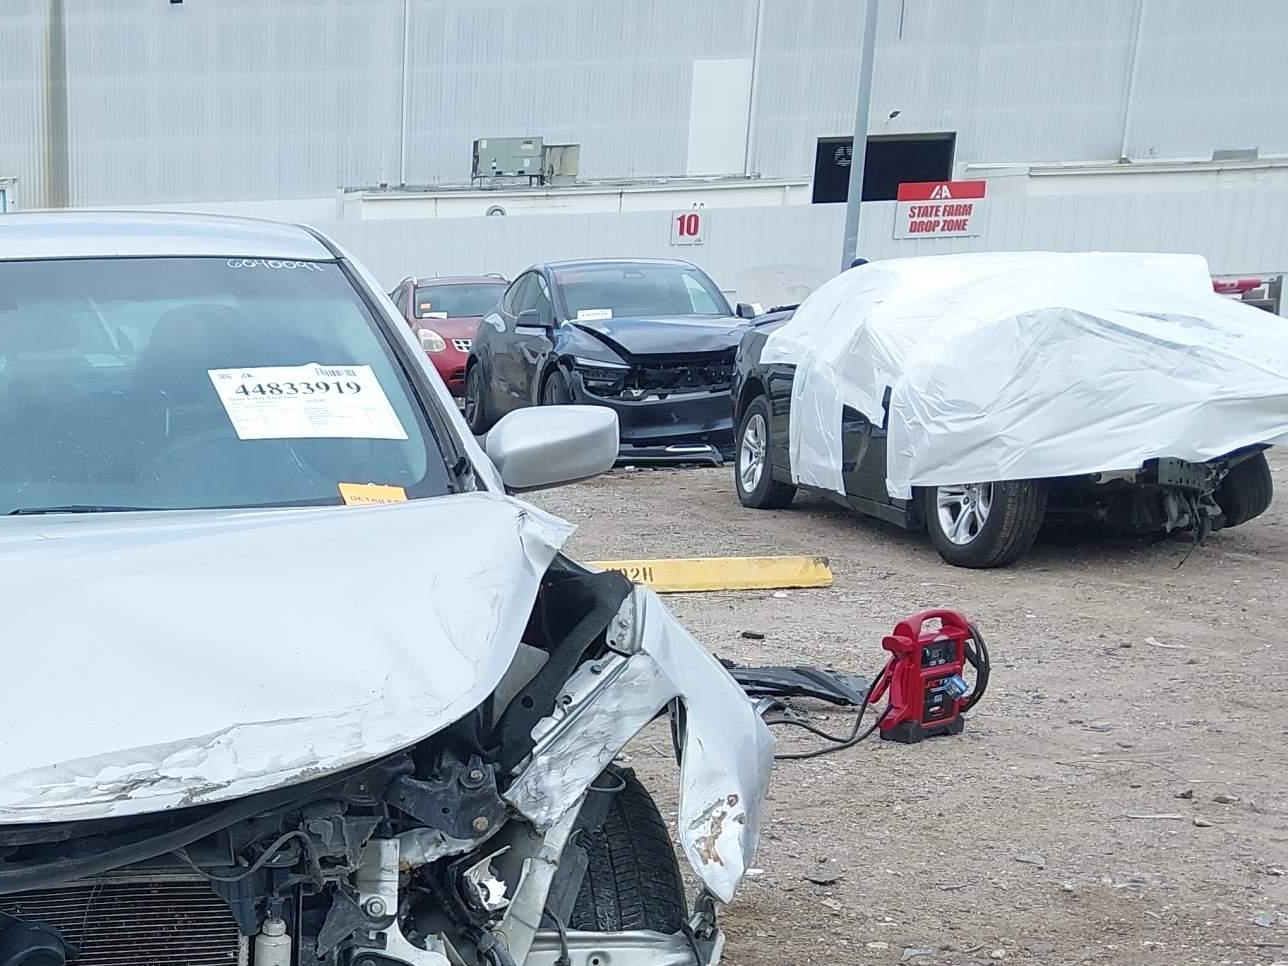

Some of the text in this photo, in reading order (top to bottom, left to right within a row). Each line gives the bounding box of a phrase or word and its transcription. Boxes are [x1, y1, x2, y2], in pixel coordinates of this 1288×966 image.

[908, 203, 973, 218] STATE FARM
[676, 213, 699, 236] 10
[909, 219, 969, 233] DROP ZONE
[235, 381, 362, 396] 44833919
